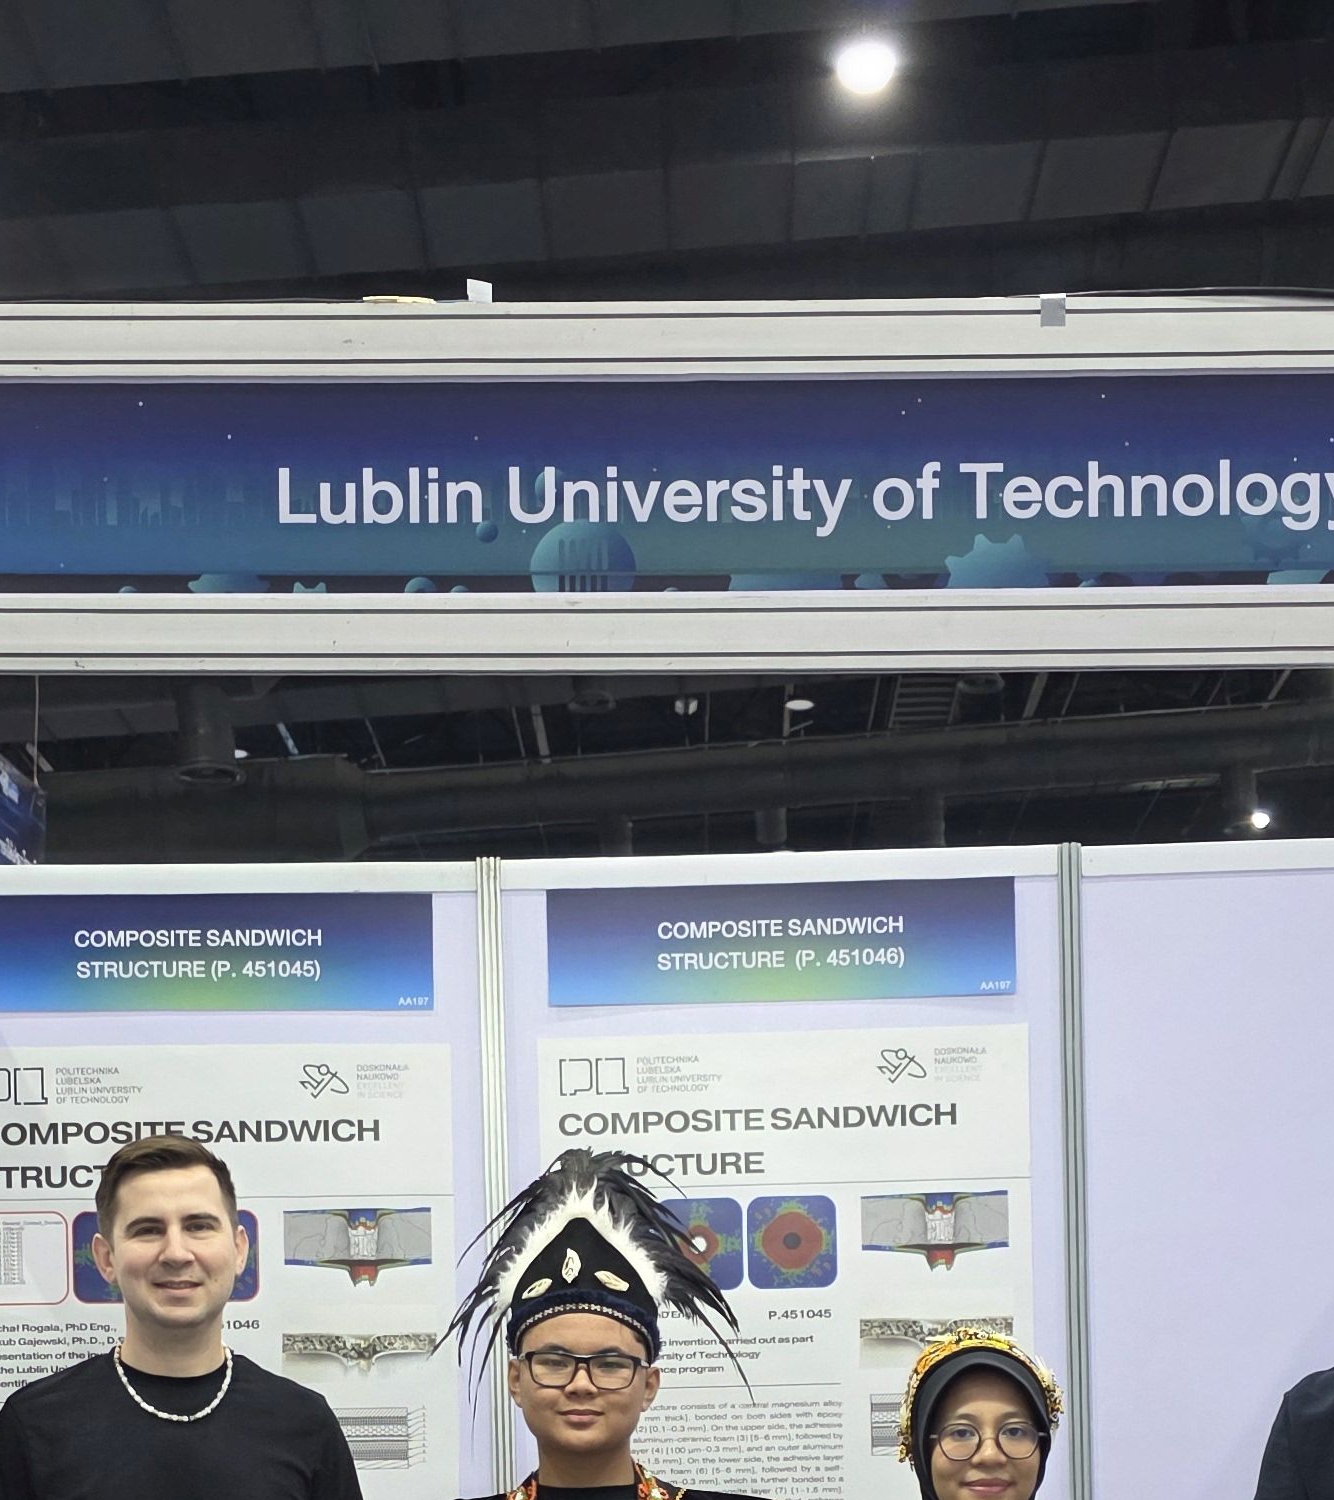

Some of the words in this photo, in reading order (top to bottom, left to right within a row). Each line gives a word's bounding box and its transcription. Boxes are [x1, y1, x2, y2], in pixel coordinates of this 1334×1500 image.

[278, 465, 483, 525] Lublin
[508, 465, 852, 537] University
[873, 462, 939, 522] of
[657, 919, 783, 940] COMPOSITE
[788, 916, 904, 937] SANDWICH
[74, 929, 202, 948] COMPOSITE
[206, 928, 322, 947] SANDWICH
[657, 951, 785, 970] STRUCTURE
[795, 950, 821, 971] (P.
[826, 947, 905, 968] 451046)
[76, 960, 206, 979] STRUCTURE
[211, 959, 237, 982] (P.
[242, 959, 321, 982] 451045)
[636, 1055, 700, 1065] POLITECHNIKA
[55, 1067, 120, 1075] POLITECHNIKA
[637, 1066, 682, 1075] LUBELSKA
[55, 1077, 102, 1085] LUBELSKA
[670, 1074, 722, 1083] UNIVERSITY
[55, 1087, 88, 1095] LUBLIN
[90, 1086, 143, 1094] UNIVERSITY
[652, 1084, 710, 1093] TECHNOLOGY
[56, 1097, 67, 1105] OF
[70, 1095, 130, 1104] TECHNOLOGY
[558, 1108, 765, 1137] COMPOSITE
[770, 1103, 957, 1130] SANDWICH
[191, 1118, 381, 1142] SANDWICH
[768, 1309, 832, 1320] P.451045
[22, 1323, 64, 1333] Rogala,
[65, 1323, 88, 1332] PhD
[90, 1323, 117, 1333] Eng.,
[18, 1336, 70, 1348] Gajewski,
[669, 1337, 717, 1346] invention
[758, 1336, 775, 1344] out
[777, 1336, 790, 1344] as
[792, 1335, 814, 1345] part
[55, 1351, 66, 1360] of
[68, 1351, 86, 1360] the
[686, 1351, 696, 1360] of
[16, 1365, 49, 1374] Lublin
[678, 1365, 724, 1375] program
[771, 1401, 819, 1409] magnesium
[695, 1413, 727, 1421] bonded
[796, 1411, 813, 1419] with
[725, 1423, 739, 1431] the
[740, 1424, 766, 1432] upper
[762, 1465, 797, 1473] followed
[792, 1475, 824, 1483] bonded
